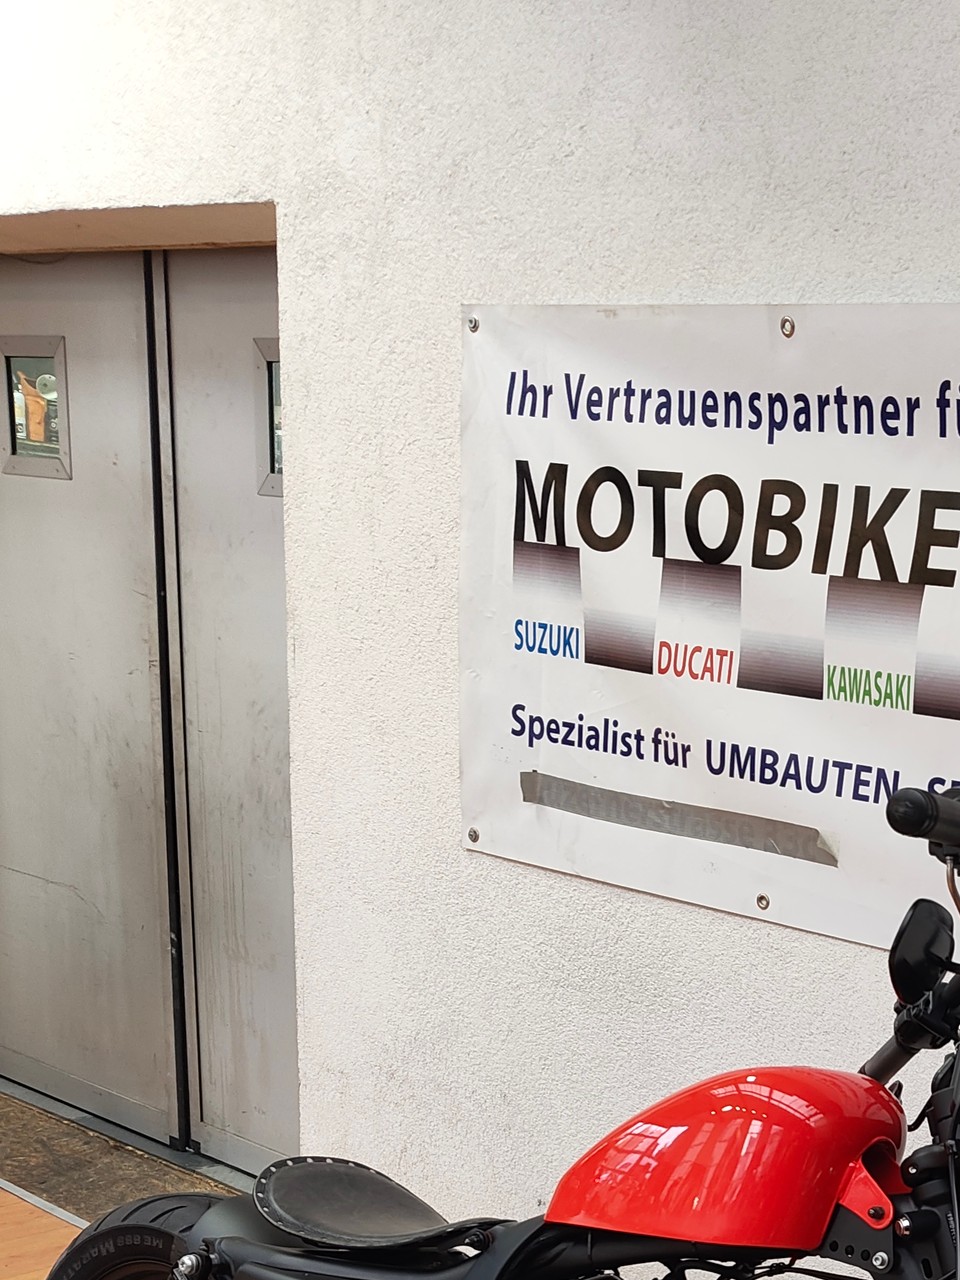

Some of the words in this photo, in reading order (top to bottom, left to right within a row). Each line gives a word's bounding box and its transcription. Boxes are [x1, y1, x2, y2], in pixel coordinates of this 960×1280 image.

[505, 369, 553, 419] Ihr
[563, 373, 921, 445] Vertrauenspartner
[513, 617, 581, 660] SUZUKI
[656, 640, 735, 685] DUCATI
[825, 664, 912, 711] KAWASAKI
[510, 703, 645, 760] Spezialist
[651, 727, 692, 769] für
[706, 739, 901, 806] UMBAUTEN
